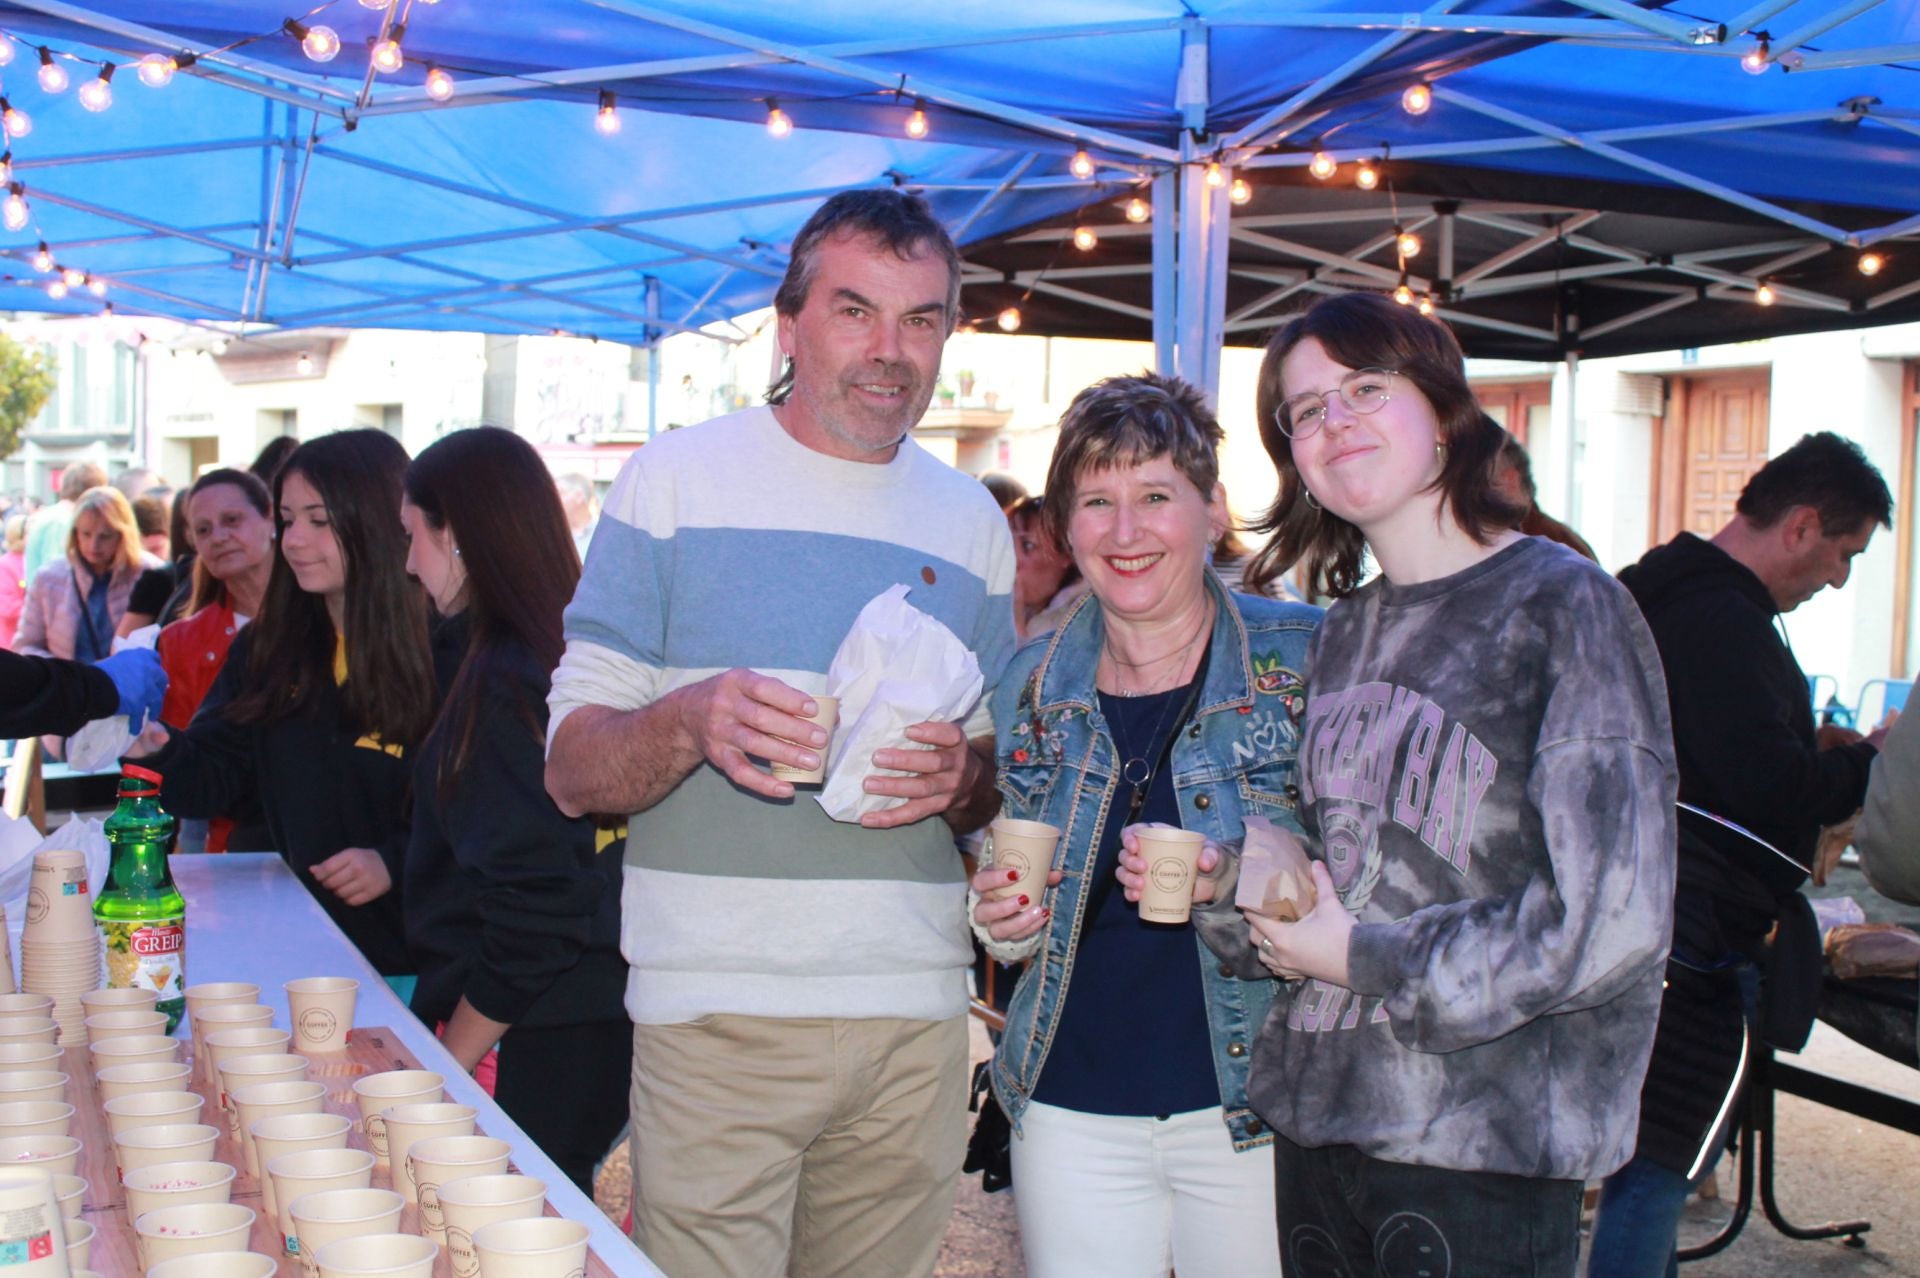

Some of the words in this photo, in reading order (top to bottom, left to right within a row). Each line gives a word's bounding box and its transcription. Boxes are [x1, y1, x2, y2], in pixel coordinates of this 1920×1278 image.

[1301, 681, 1421, 824] THERN
[1392, 699, 1498, 877] BAY
[134, 933, 182, 953] GREIP
[306, 1020, 329, 1029] COFFEE
[371, 1131, 387, 1139] COFF
[422, 1200, 441, 1211] COFFE
